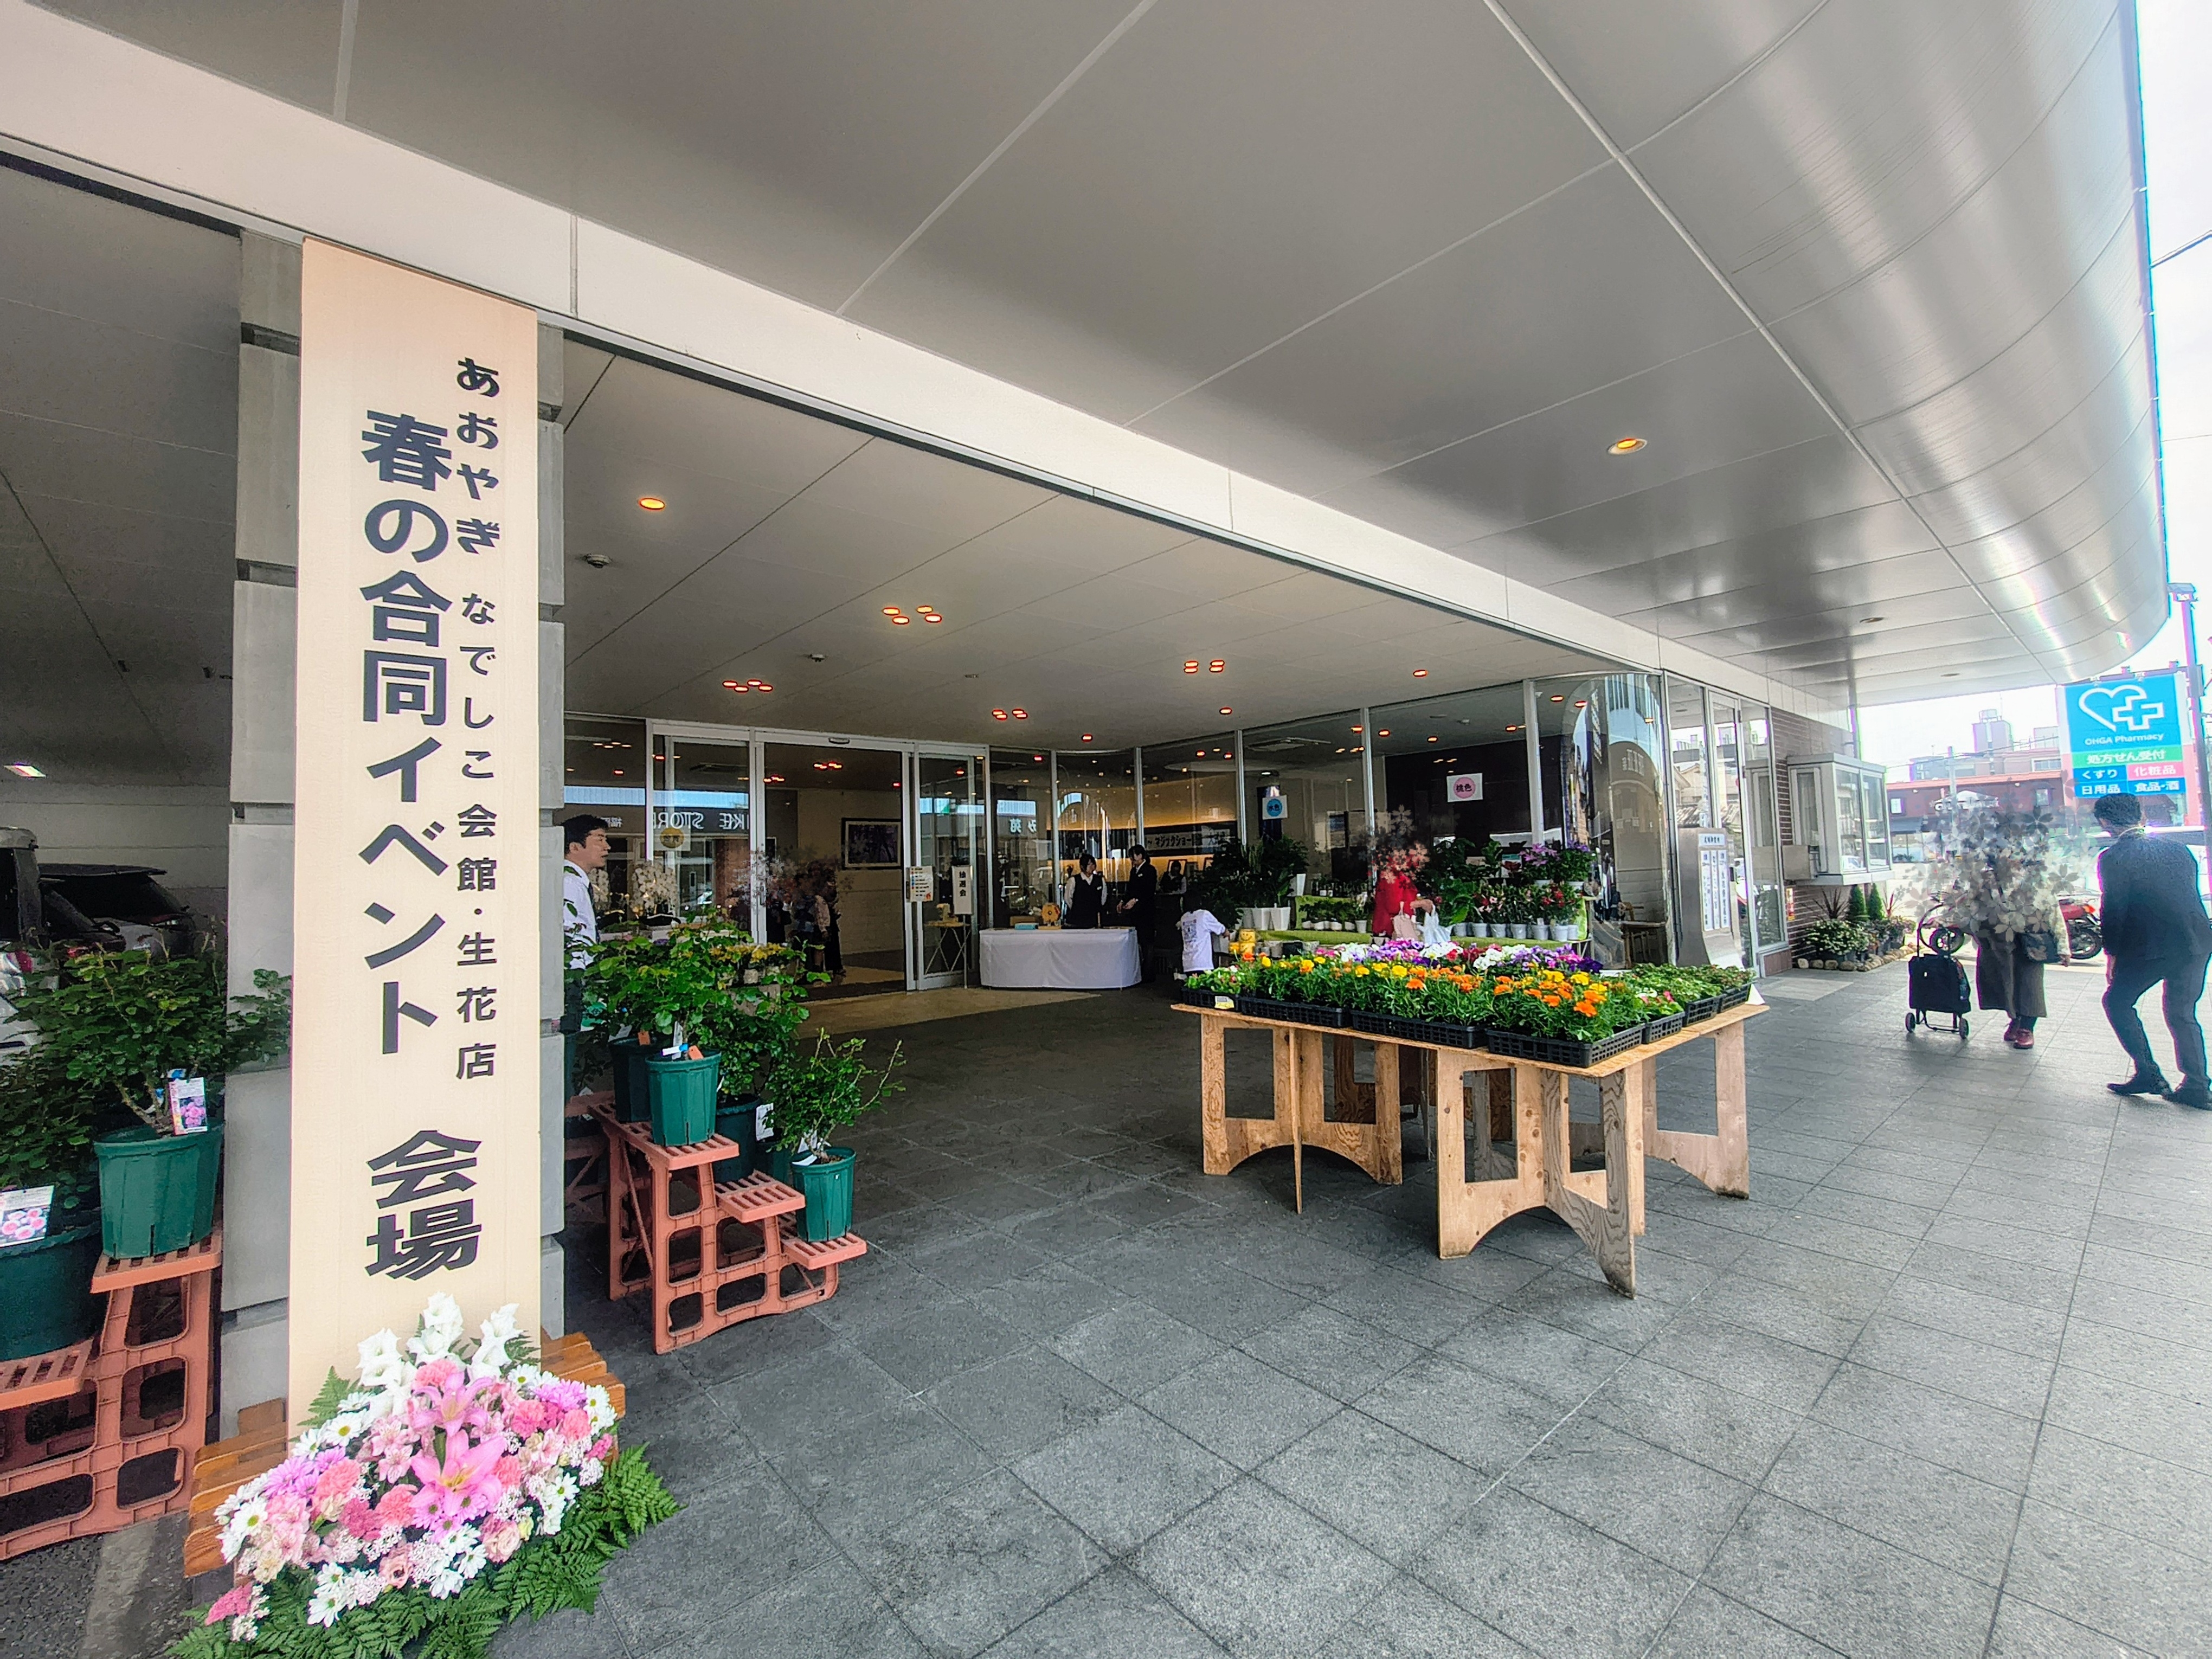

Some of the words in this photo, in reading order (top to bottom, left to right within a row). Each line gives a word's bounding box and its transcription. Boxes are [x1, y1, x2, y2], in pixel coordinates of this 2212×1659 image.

[457, 357, 499, 554] あおやぎ
[359, 410, 452, 1054] 春の合同イベント
[2115, 733, 2164, 743] Pharmacy
[2086, 749, 2166, 764] 処方せん受付
[2082, 769, 2117, 779] くすり
[2134, 765, 2176, 776] 化粧品
[2082, 784, 2121, 795] 日用品
[456, 594, 497, 1079] なでしこ会館・生花店
[365, 1130, 481, 1281] 会場
